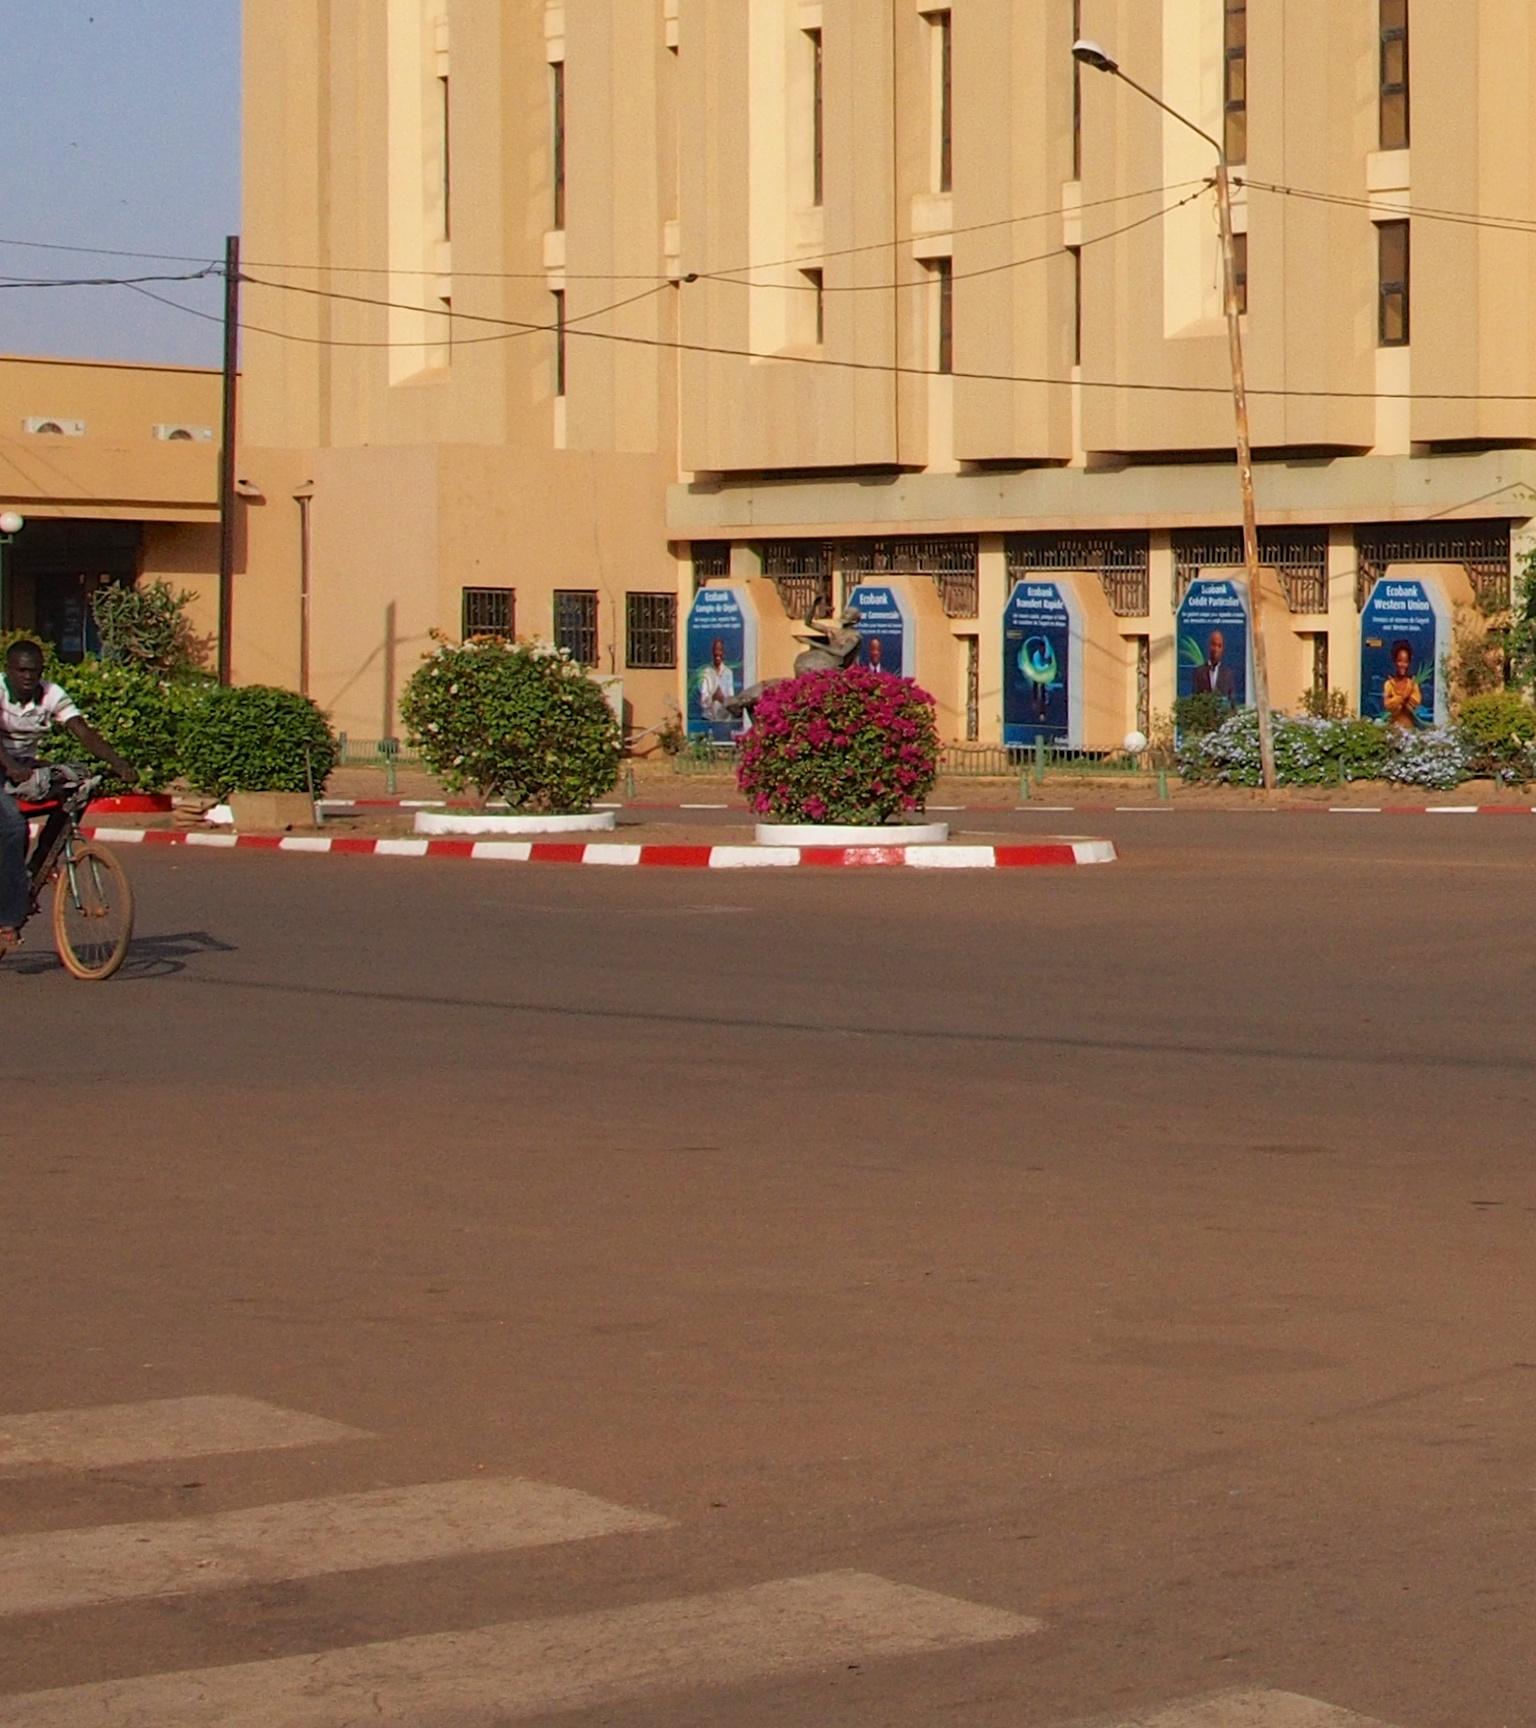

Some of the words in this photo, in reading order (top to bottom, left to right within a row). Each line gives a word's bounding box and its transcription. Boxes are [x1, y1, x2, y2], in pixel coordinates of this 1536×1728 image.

[1386, 585, 1418, 597] Ecobank
[859, 592, 888, 605] Ecobank
[1374, 599, 1406, 610] Western
[1407, 599, 1429, 610] Union
